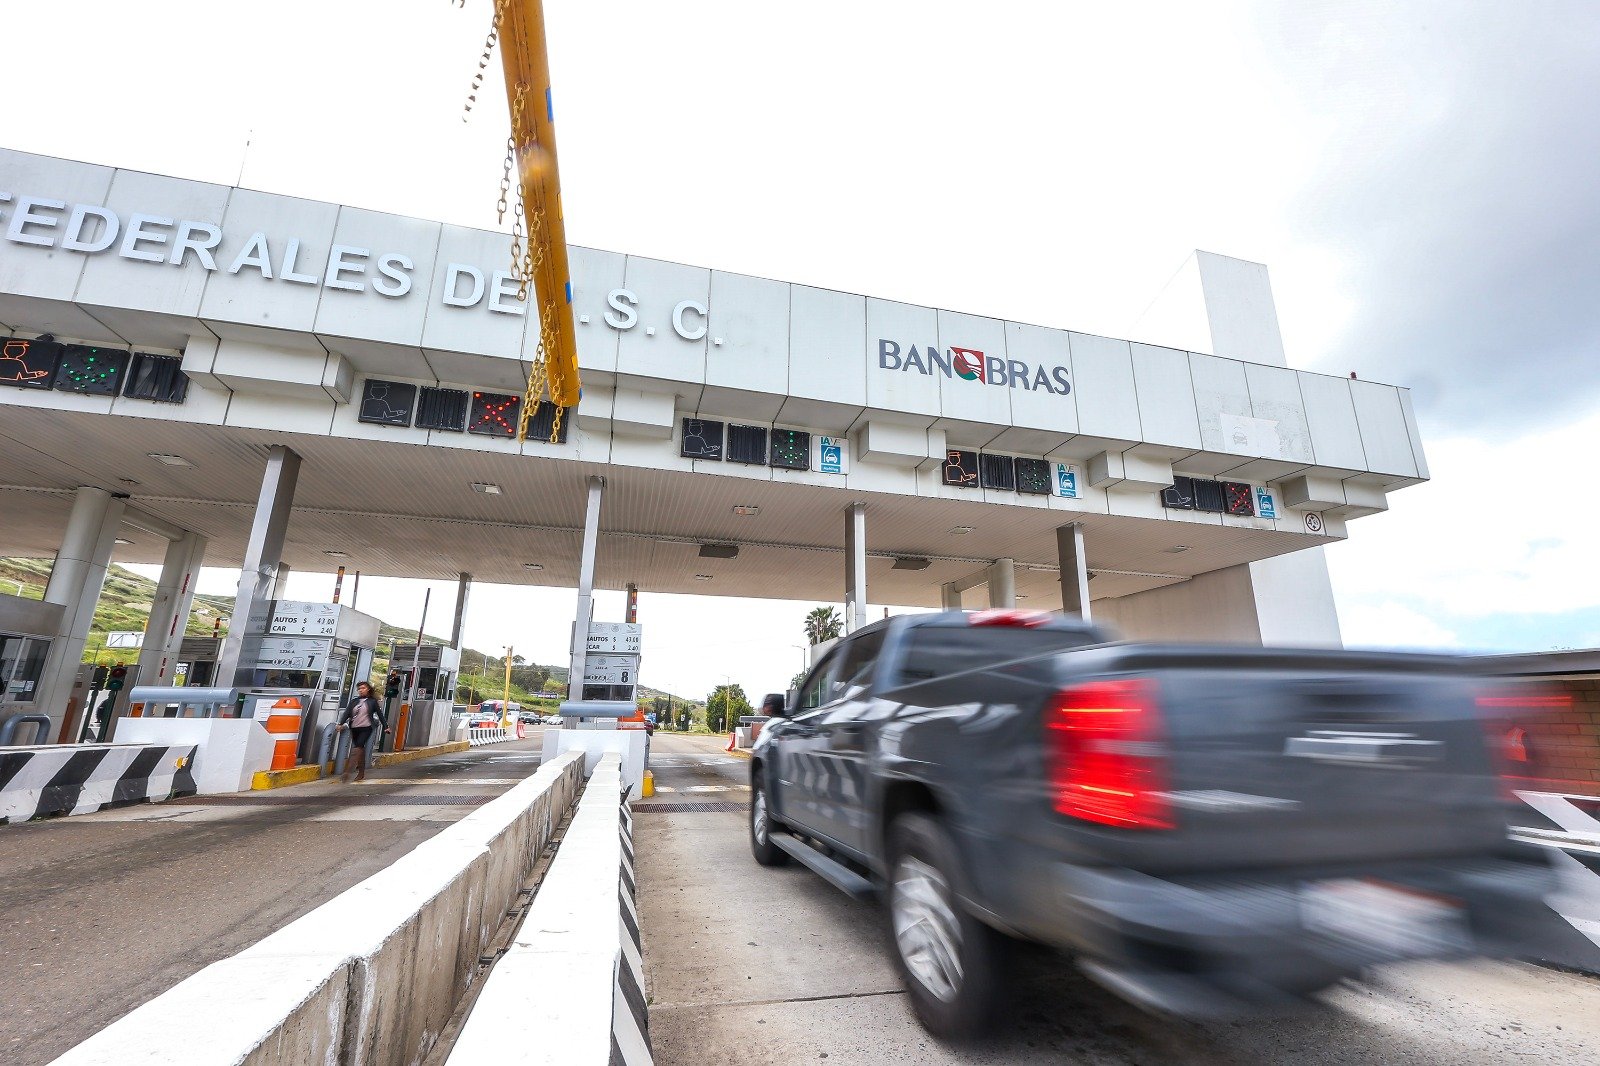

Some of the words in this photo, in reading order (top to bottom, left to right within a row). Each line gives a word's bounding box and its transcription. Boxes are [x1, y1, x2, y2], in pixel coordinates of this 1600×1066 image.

[443, 262, 532, 316] DE
[274, 616, 298, 624] AUTOS
[307, 655, 316, 668] 7
[621, 671, 629, 683] 8
